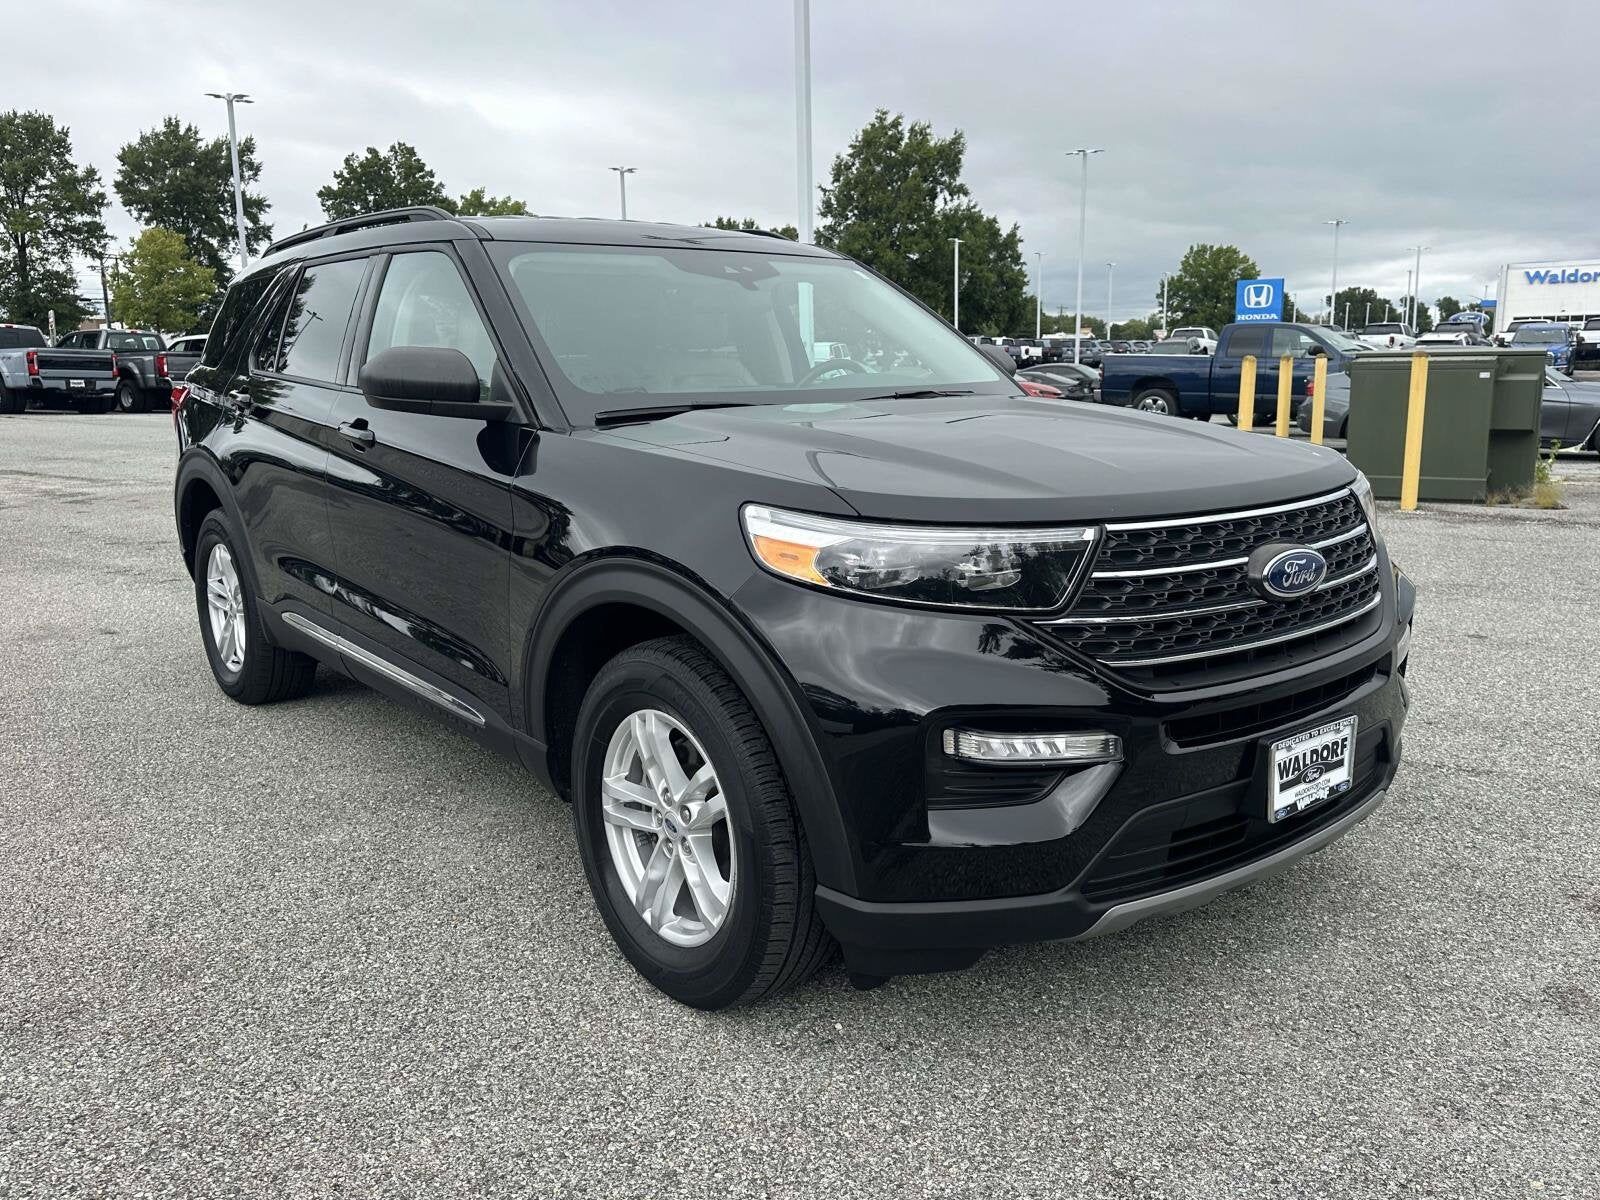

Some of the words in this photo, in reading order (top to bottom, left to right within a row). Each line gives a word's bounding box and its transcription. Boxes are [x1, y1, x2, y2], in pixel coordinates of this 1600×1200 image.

[1237, 313, 1279, 321] HONDA
[1282, 558, 1317, 588] Ford
[1278, 733, 1310, 750] DEDICATED
[1310, 730, 1319, 738] TO
[1319, 718, 1354, 735] EXCELLENCE
[1277, 736, 1348, 781] WALDORF
